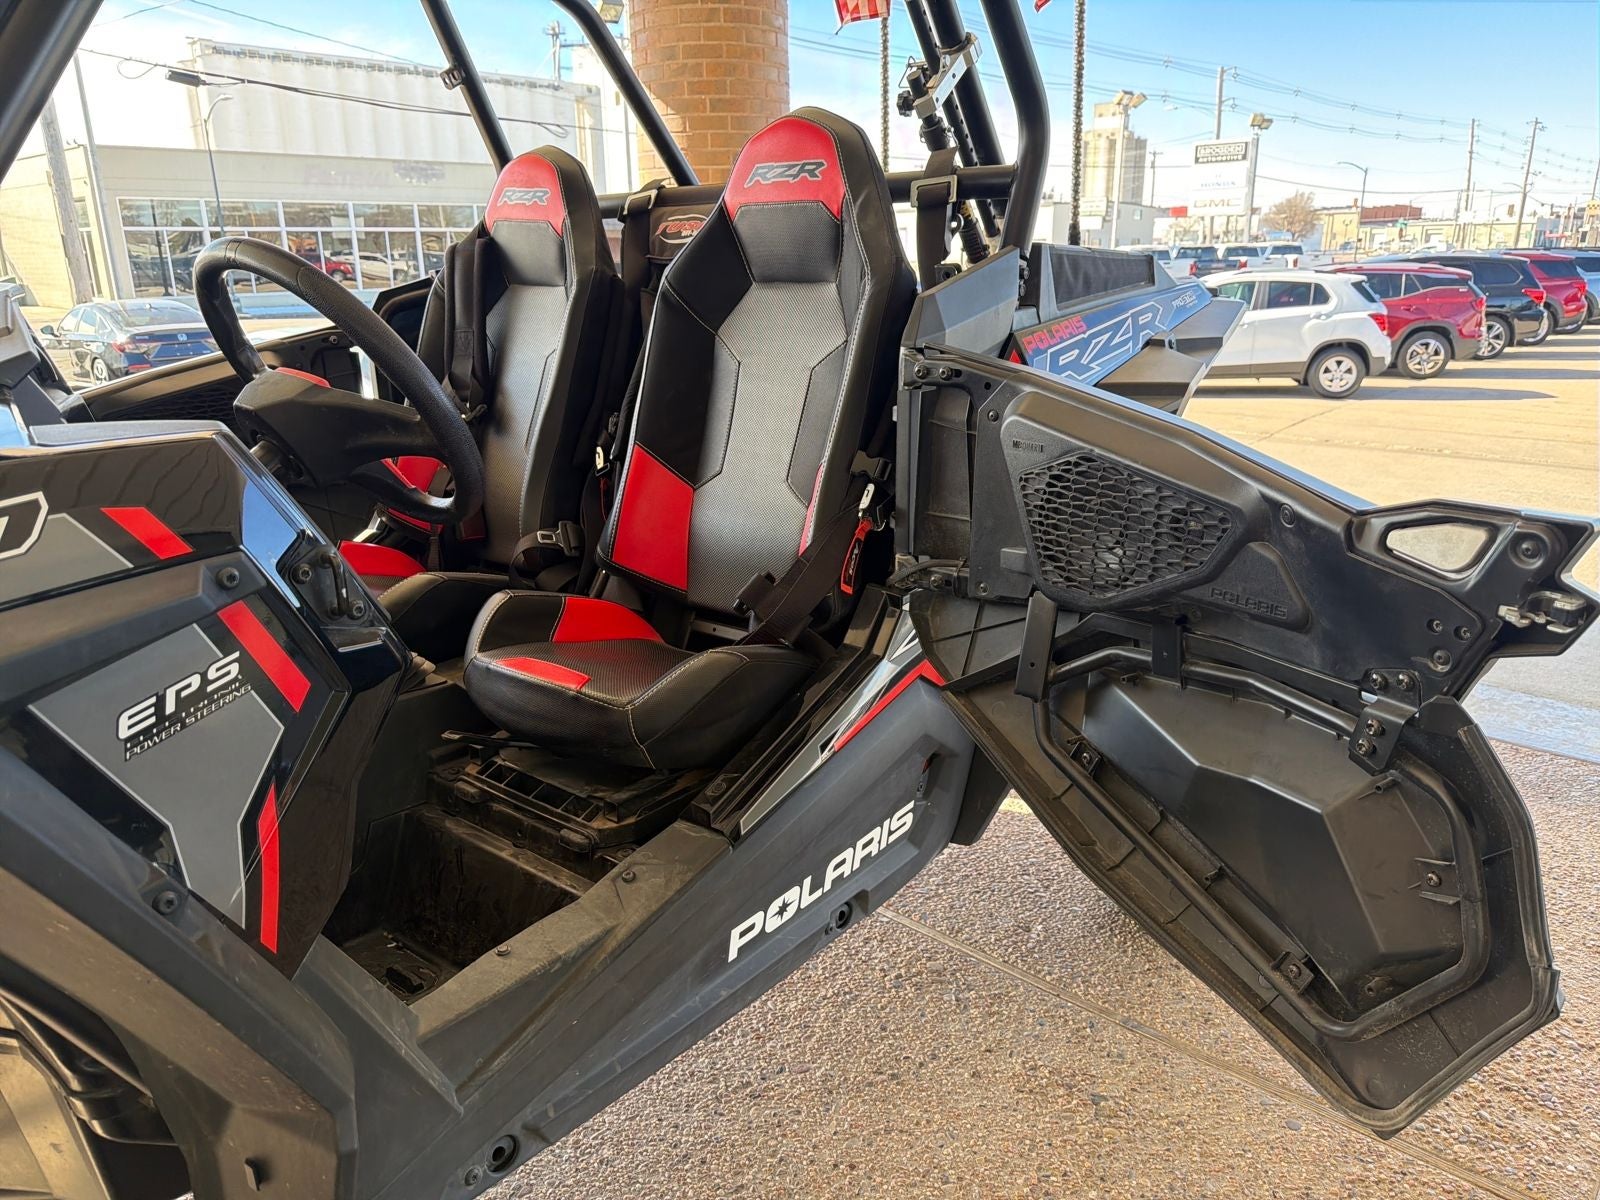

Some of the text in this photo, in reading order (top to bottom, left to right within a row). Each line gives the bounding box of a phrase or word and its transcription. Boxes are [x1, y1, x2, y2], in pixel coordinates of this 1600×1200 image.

[743, 159, 827, 189] RZR
[497, 187, 551, 207] RZR
[1193, 199, 1242, 209] GMC
[1022, 315, 1088, 354] POLARIS
[1045, 301, 1166, 382] RZR
[1210, 586, 1289, 619] POLARIS
[117, 650, 240, 741] EPS
[125, 683, 252, 760] POWER STEERING
[727, 799, 915, 963] POLARIS
